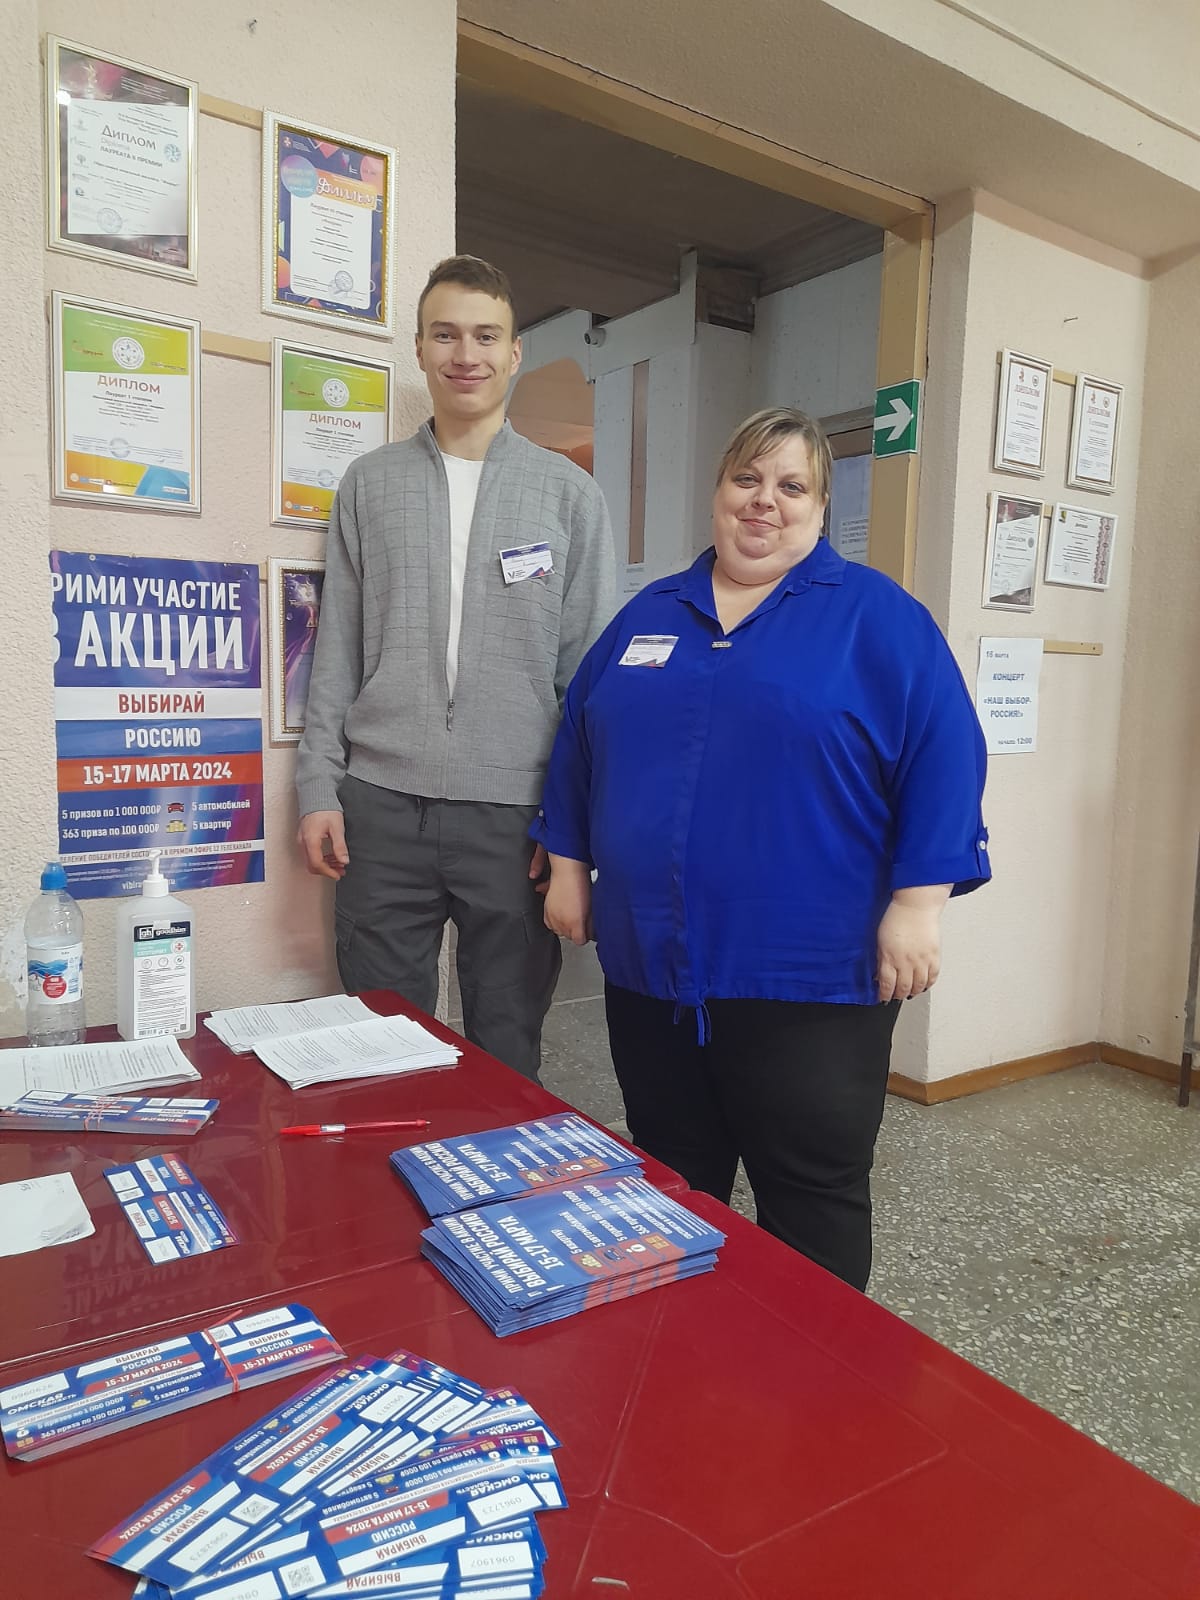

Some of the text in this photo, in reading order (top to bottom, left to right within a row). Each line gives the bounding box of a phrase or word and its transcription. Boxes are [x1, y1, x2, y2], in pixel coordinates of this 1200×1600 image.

[97, 375, 160, 395] ДИПЛОМ
[309, 414, 361, 430] ДИПЛОМ
[136, 577, 241, 611] УЧАСТИЕ
[74, 611, 244, 676] АКЦИИ
[993, 674, 1025, 682] КОНЦЕРТ
[118, 691, 205, 714] ВЫБИРАЙ
[125, 728, 201, 749] РОССИЮ
[84, 762, 232, 785] 15-17 МАРТА 2024
[62, 810, 68, 820] 5
[69, 810, 102, 820] призов
[103, 808, 114, 817] по
[116, 807, 120, 816] 1
[122, 806, 138, 816] 000
[192, 799, 250, 810] 5 автомобилей
[62, 828, 79, 840] 363
[81, 828, 108, 839] приза
[109, 828, 120, 836] по
[122, 826, 138, 835] 100
[192, 820, 232, 830] 5 квартир
[423, 1142, 495, 1195] ВЫБИРАЙ РОССИЮ
[455, 1143, 513, 1182] 15-17 МАРТА
[440, 1216, 473, 1239] АКЦИИ
[457, 1212, 548, 1290] ВЫБИРАЙ РОССИЮ
[464, 1241, 501, 1269] УЧАСТИЕ
[492, 1215, 566, 1270] 15-17 МАРТА
[488, 1266, 525, 1294] ПРИМИ
[246, 1329, 291, 1347] ВЫБИРАЙ
[254, 1337, 295, 1354] РОССИЮ
[114, 1344, 161, 1364] ВЫБИРАЙ
[120, 1354, 163, 1372] РОССИЮ
[241, 1342, 315, 1370] 15-17 МАРТА 2024
[104, 1358, 183, 1387] 15-17 МАРТА 2024
[6, 1391, 64, 1416] ОМСКАЯ
[265, 1422, 328, 1472] 15-17 МАРТА 2024
[292, 1439, 328, 1469] РОССИЮ
[304, 1443, 344, 1477] ВЫБИРАЙ
[349, 1452, 390, 1479] ВЫБИРАЙ
[468, 1474, 521, 1497] ОМСКАЯ
[119, 1484, 196, 1540] 15-17 МАРТА 2024
[150, 1504, 192, 1535] РОССИЮ
[346, 1500, 430, 1535] 15-17 МАРТА 2024
[162, 1508, 209, 1544] ВЫБИРАЙ
[371, 1520, 417, 1544] РОССИЮ
[376, 1534, 428, 1560] ВЫБИРАЙ
[470, 1556, 516, 1568] 0961907
[346, 1572, 401, 1590] ВЫБИРАЙ
